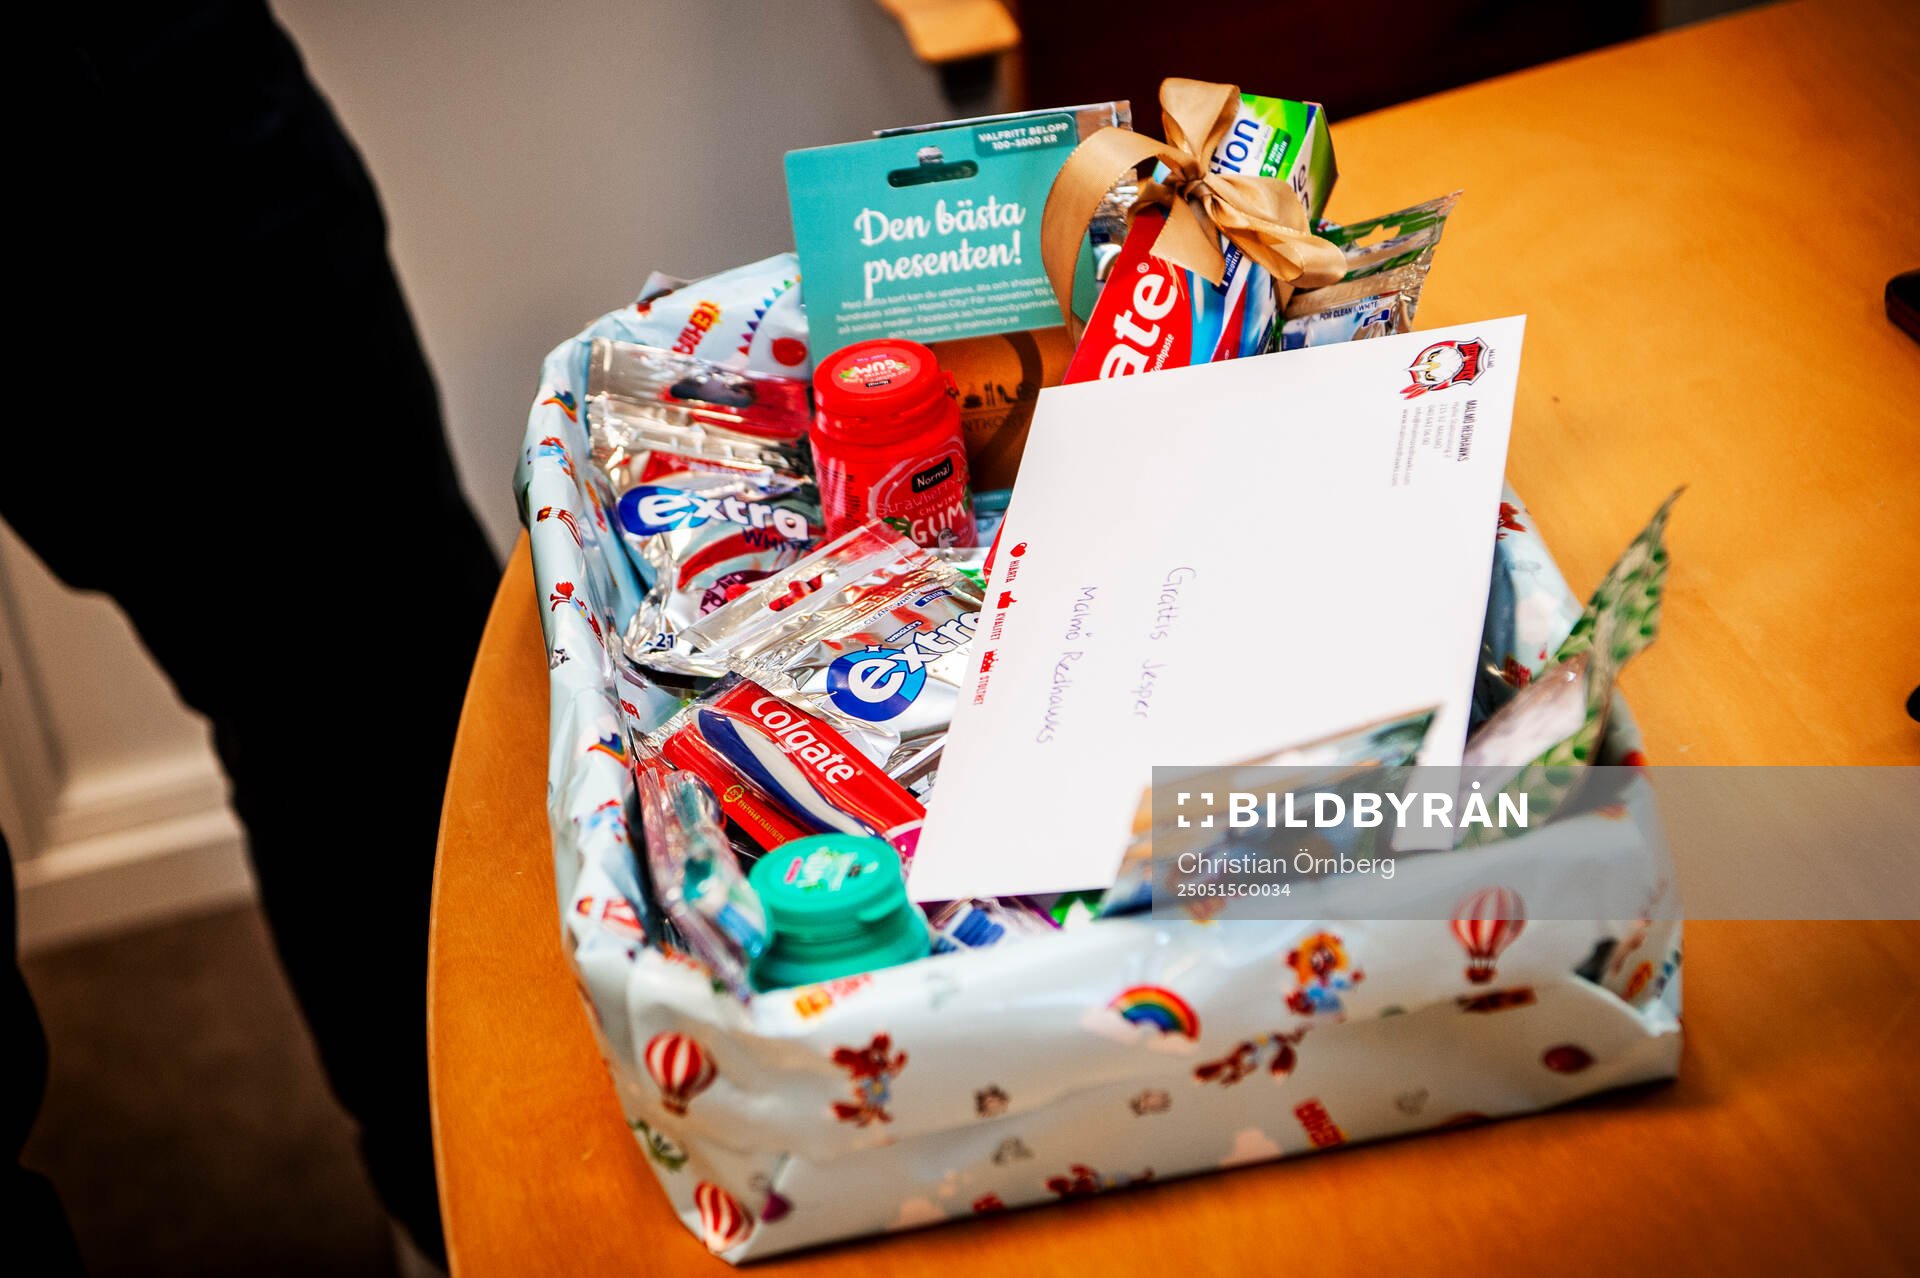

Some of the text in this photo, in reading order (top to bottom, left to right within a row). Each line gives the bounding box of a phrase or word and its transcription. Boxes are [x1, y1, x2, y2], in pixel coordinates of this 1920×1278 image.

[979, 122, 1069, 143] VALFRITT BELOPP
[1043, 134, 1058, 144] KR
[1262, 161, 1278, 179] 3
[853, 195, 1026, 246] Den bästa
[862, 230, 1023, 300] presenten!
[1457, 425, 1474, 462] REDHAWKS
[916, 463, 950, 488] Normal
[639, 492, 809, 540] extra
[911, 500, 967, 545] GUM
[1150, 566, 1197, 641] Grattis
[656, 633, 675, 649] 21
[750, 697, 855, 784] Colgate
